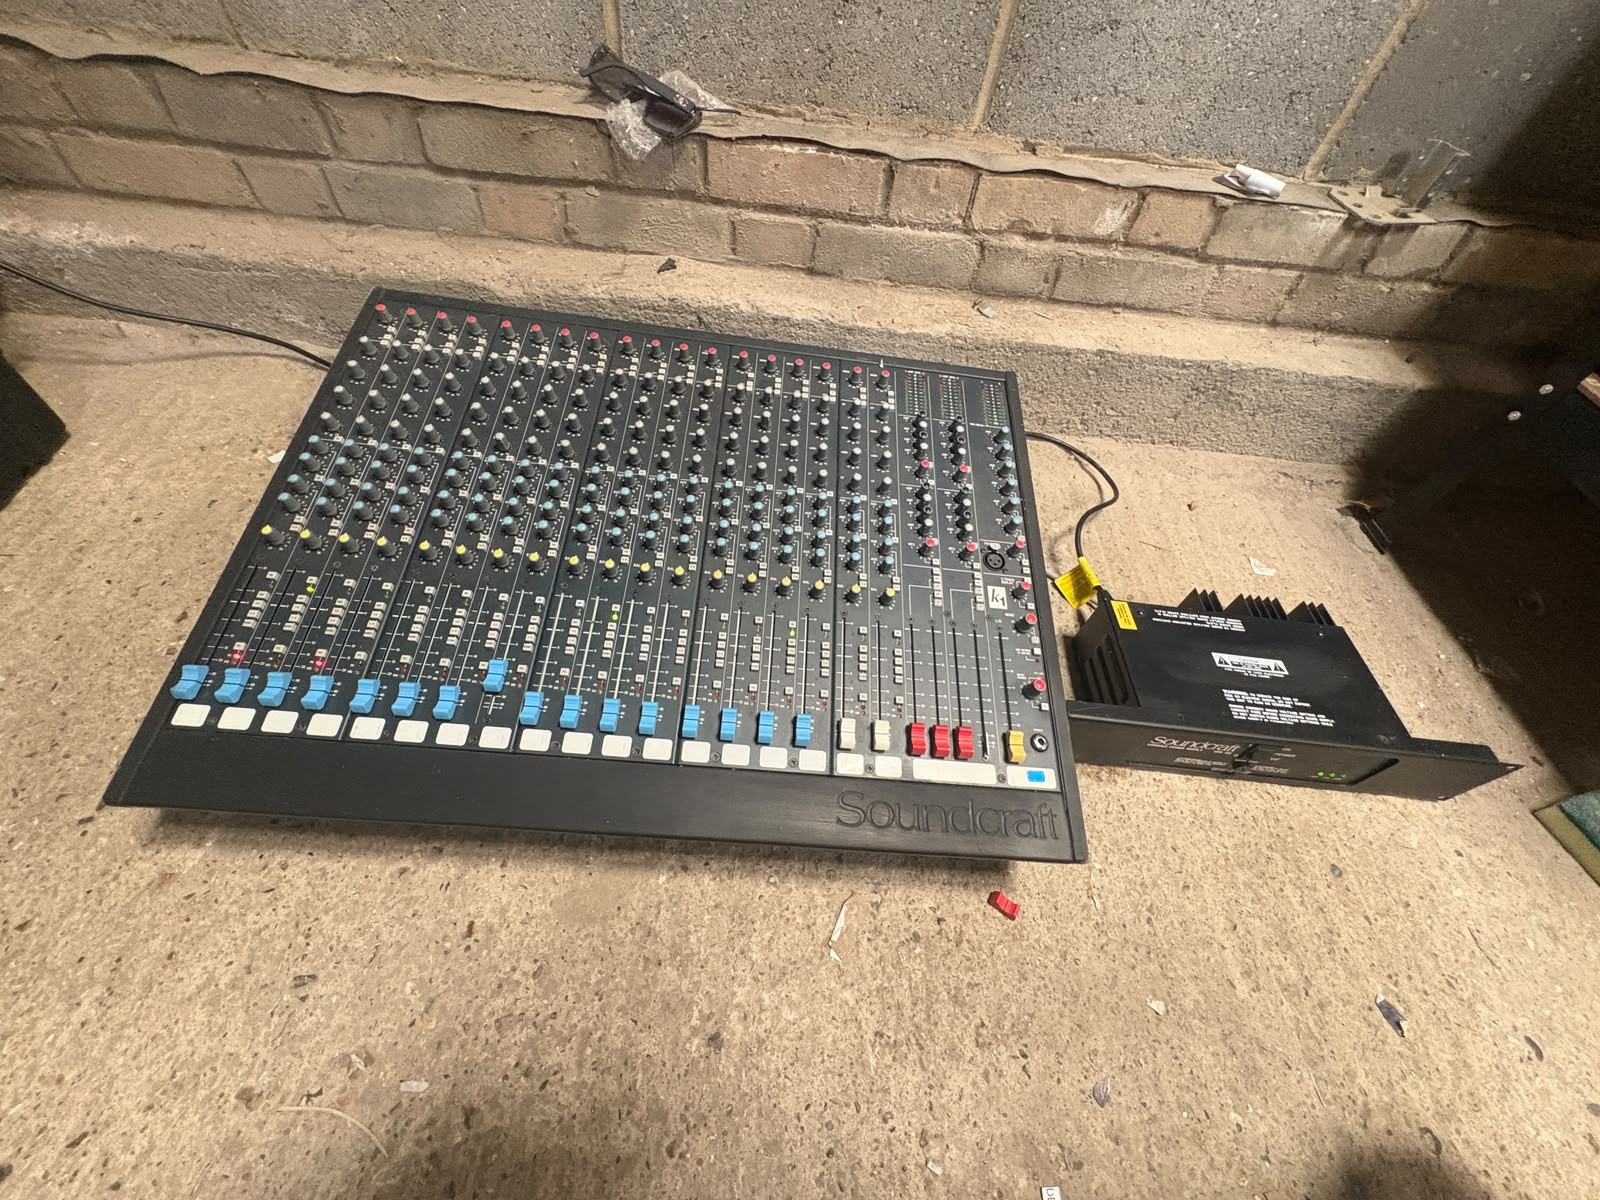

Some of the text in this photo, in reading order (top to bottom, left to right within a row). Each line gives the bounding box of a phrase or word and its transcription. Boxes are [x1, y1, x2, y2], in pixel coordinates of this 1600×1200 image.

[991, 588, 1005, 606] k1
[1150, 736, 1240, 752] Soundcraft
[836, 791, 1059, 840] Soundcraft
